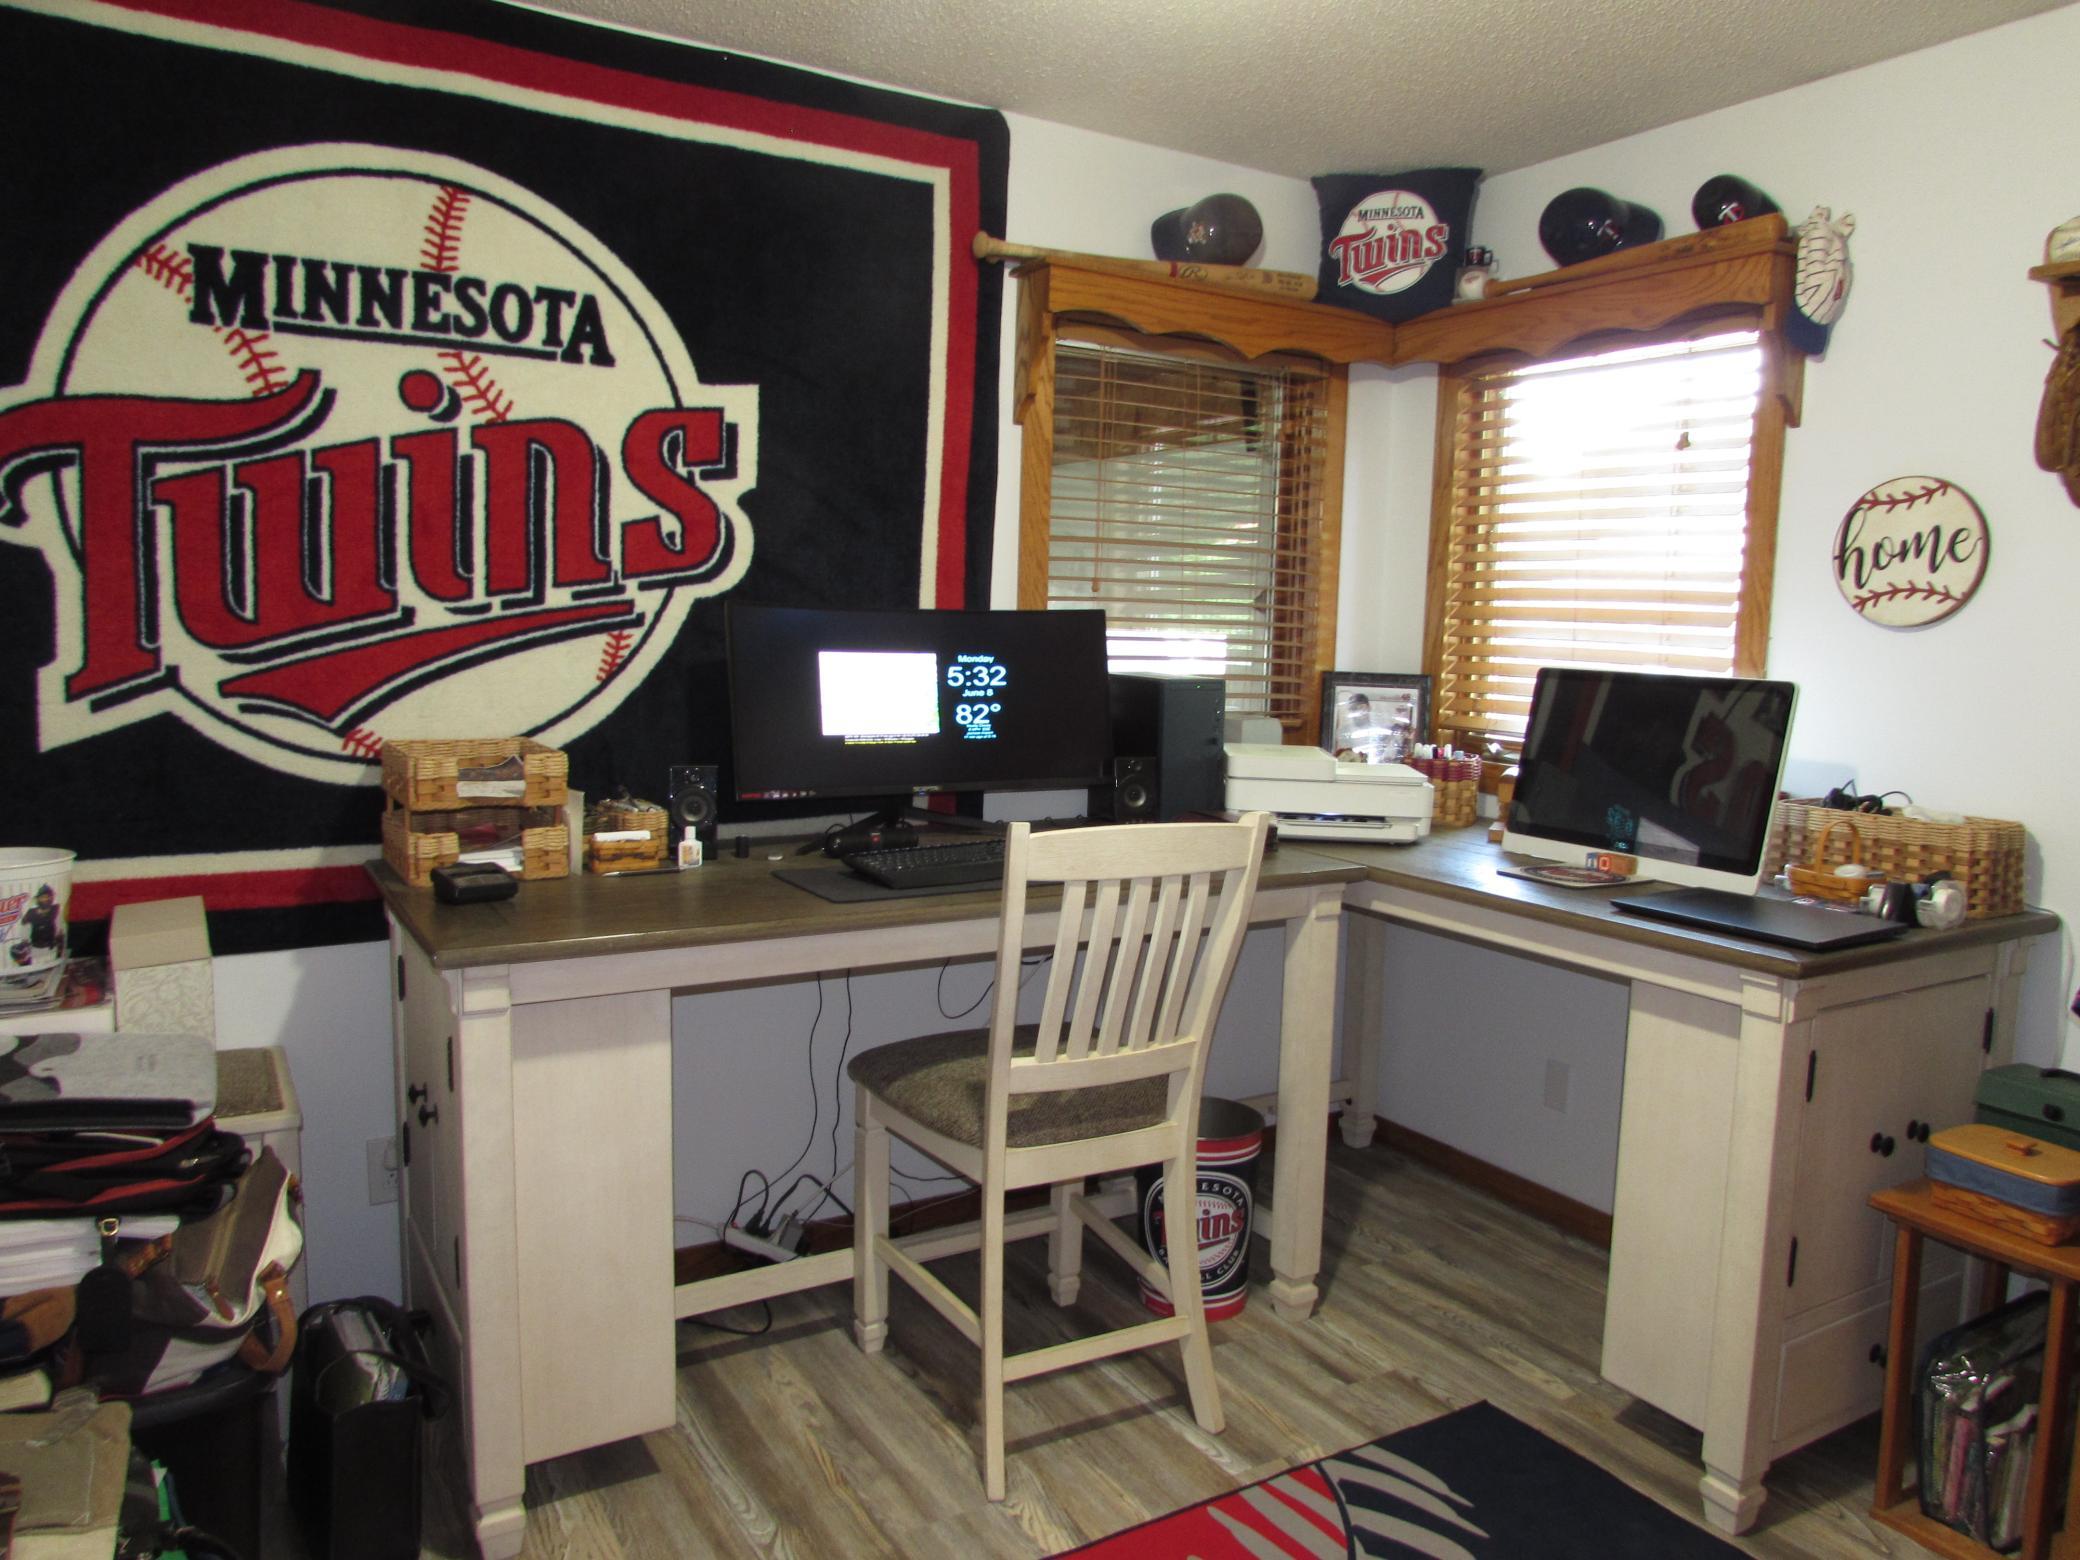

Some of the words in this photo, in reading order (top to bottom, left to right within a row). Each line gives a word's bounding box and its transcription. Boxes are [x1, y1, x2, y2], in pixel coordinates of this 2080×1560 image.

[1358, 206, 1424, 222] MINNESOTA
[1329, 224, 1449, 285] Twins
[187, 242, 616, 368] MINNESOTA
[0, 369, 738, 712] Twins
[1833, 507, 1983, 590] home
[957, 655, 994, 664] Monday
[947, 665, 1007, 687] 5:32
[962, 689, 985, 697] June
[986, 688, 994, 697] 8
[1217, 1249, 1240, 1274] CLUB
